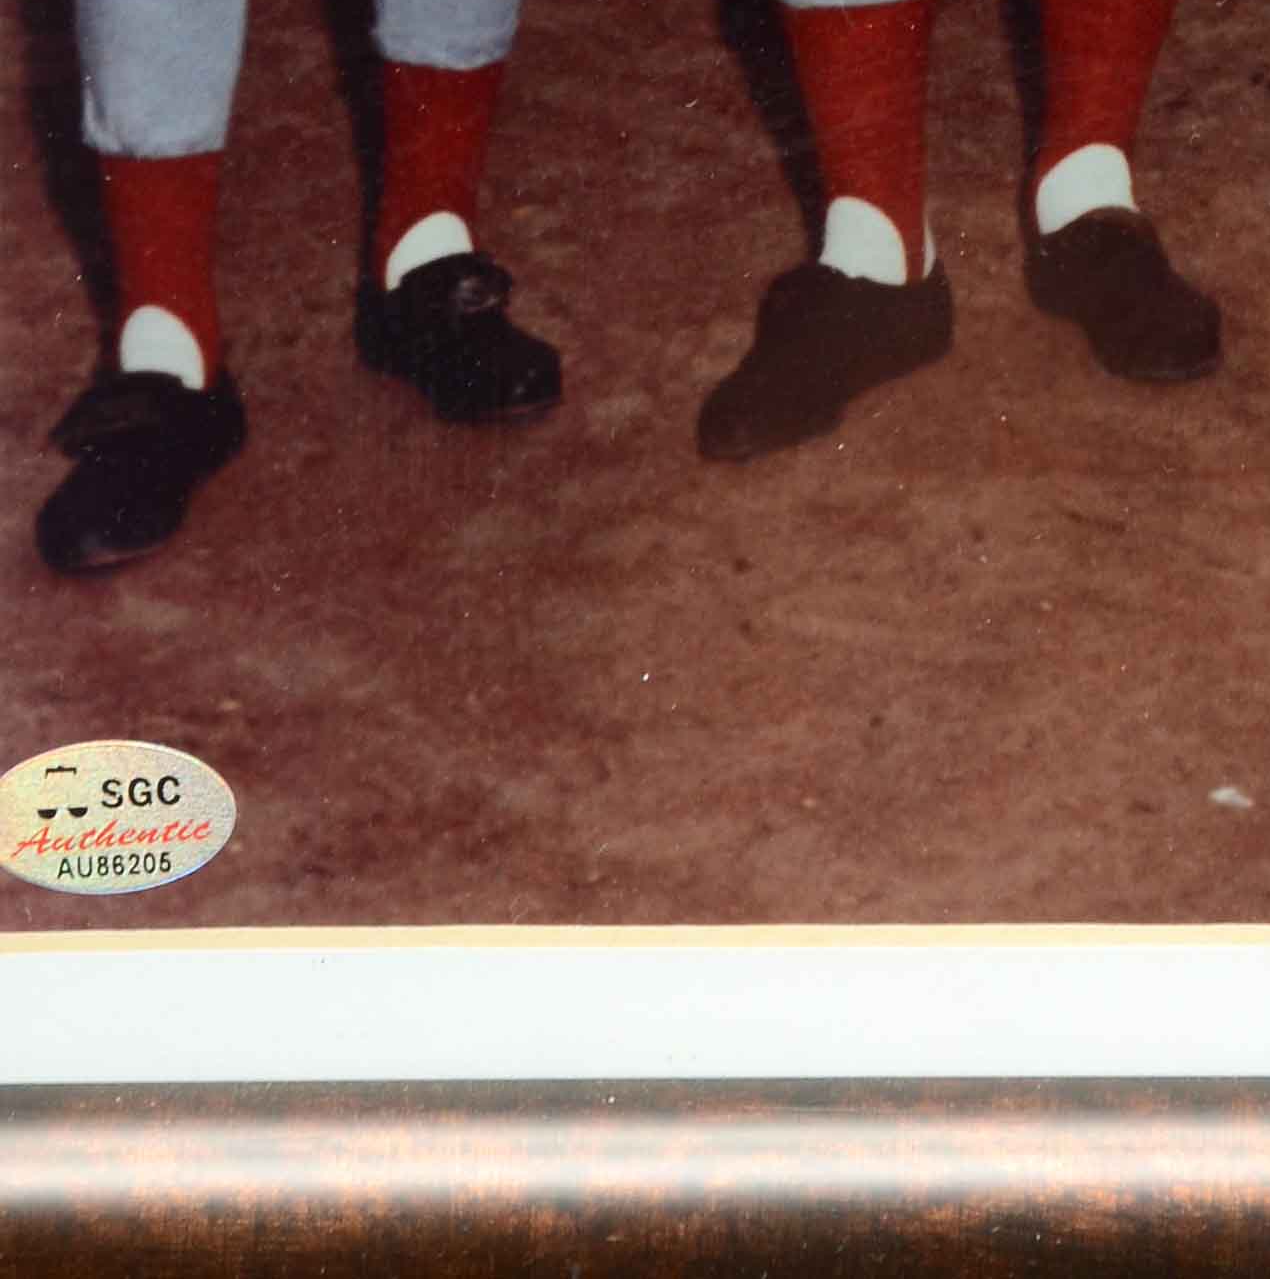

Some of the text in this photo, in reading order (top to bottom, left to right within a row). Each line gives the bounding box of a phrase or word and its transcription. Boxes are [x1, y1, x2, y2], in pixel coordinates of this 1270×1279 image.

[101, 775, 181, 809] SGC
[11, 819, 213, 860] Authentic
[57, 851, 172, 880] AU86205
